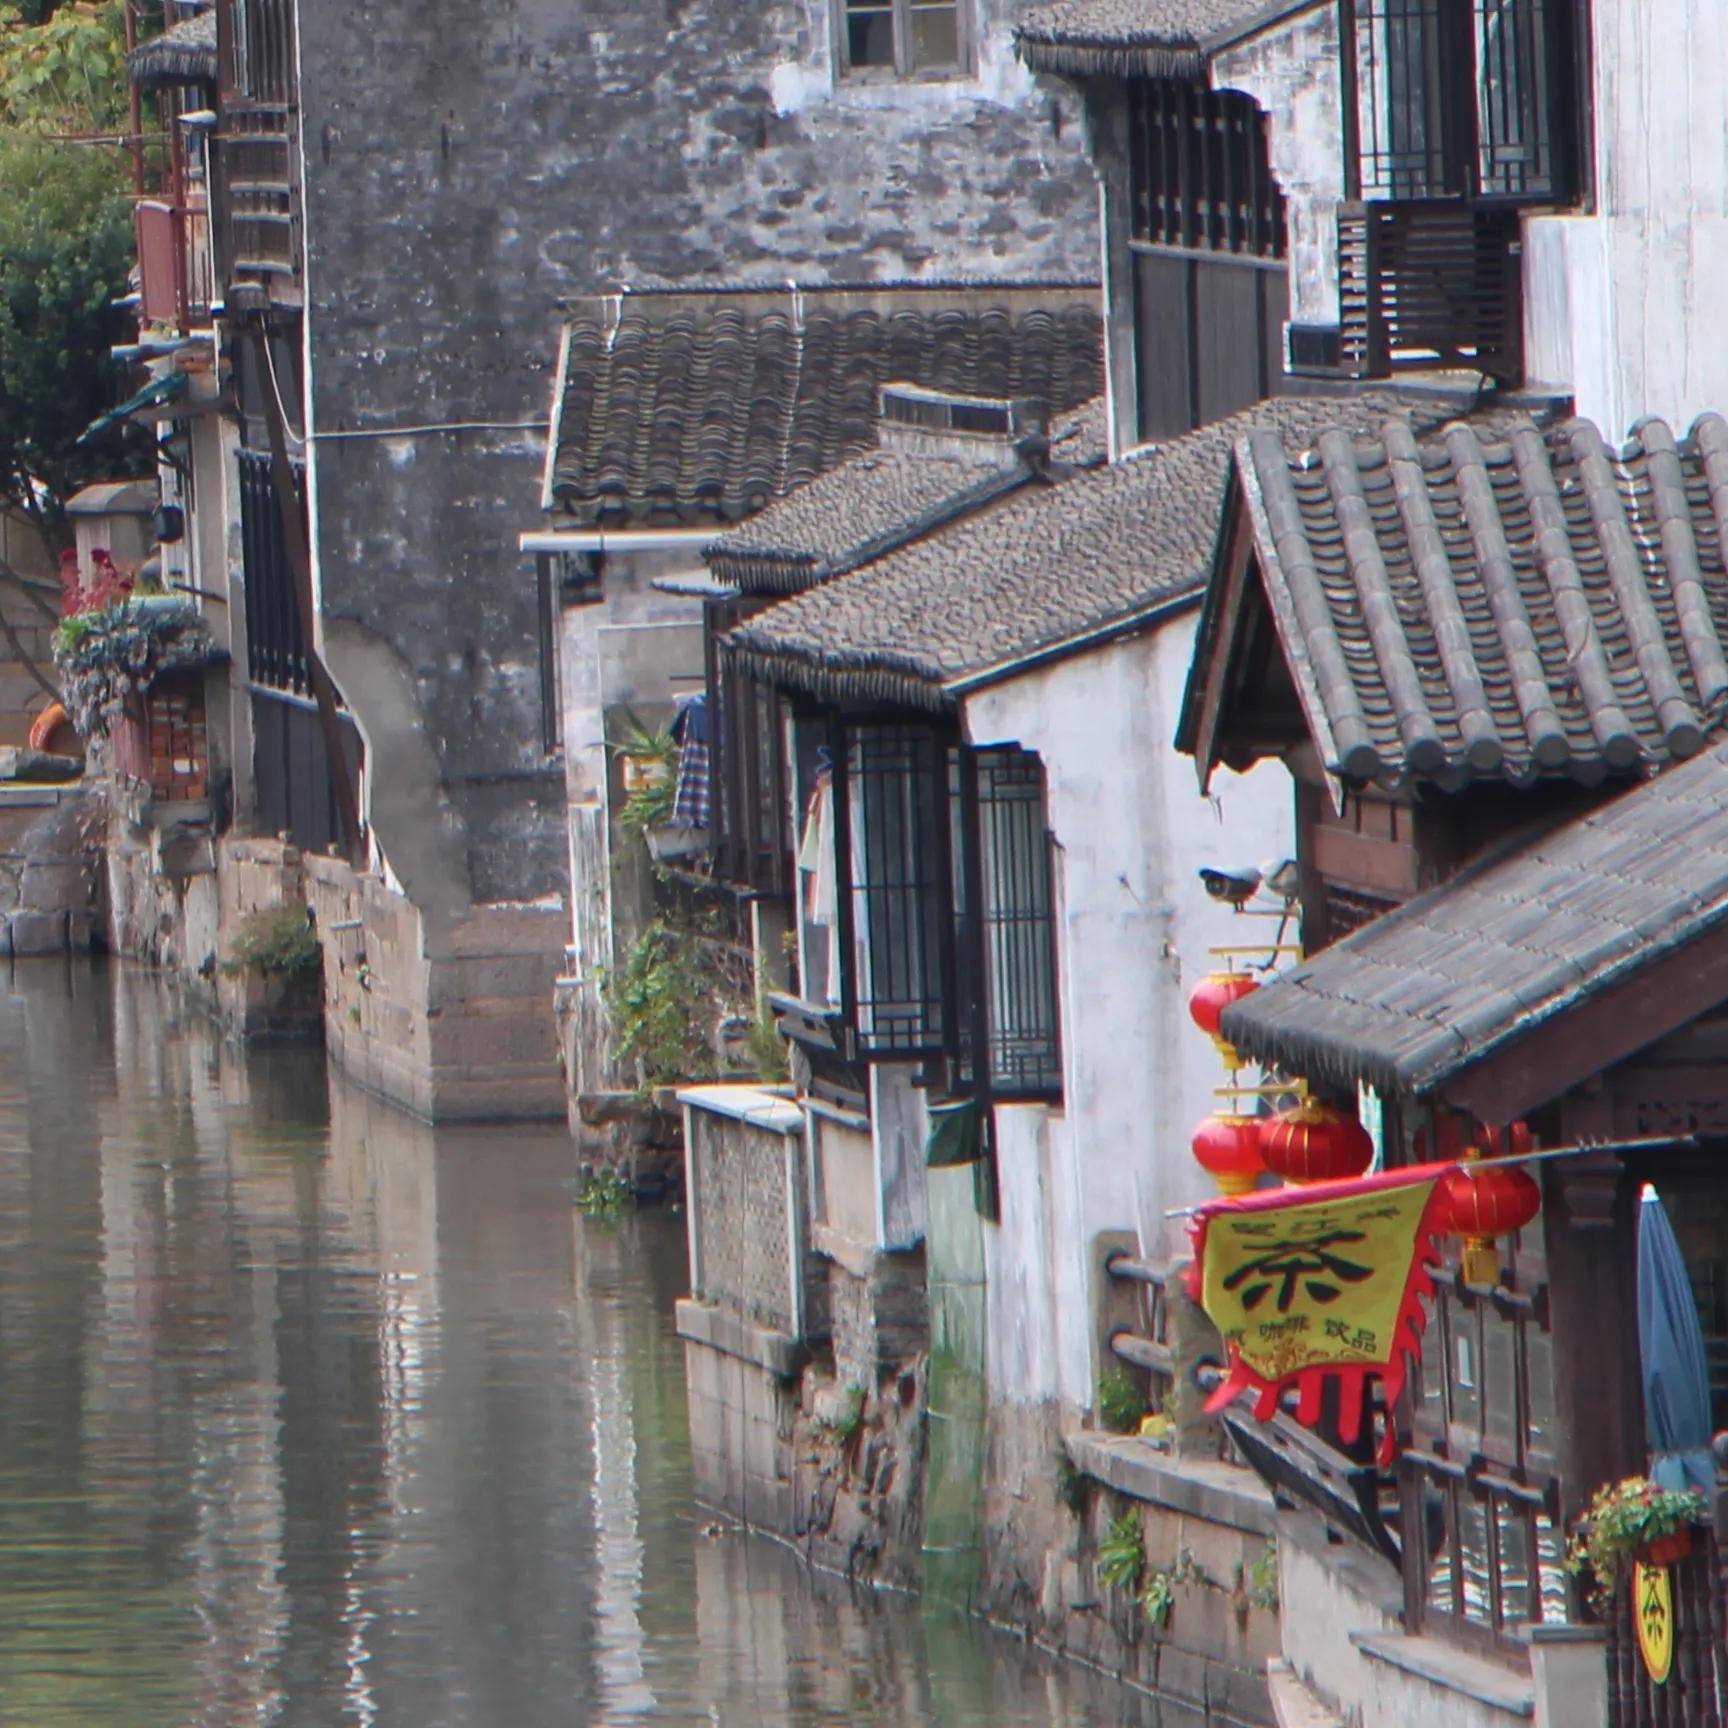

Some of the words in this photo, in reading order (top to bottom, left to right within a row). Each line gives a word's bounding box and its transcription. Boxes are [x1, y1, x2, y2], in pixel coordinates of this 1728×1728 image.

[1222, 1229, 1375, 1313] 茶
[1324, 1317, 1378, 1355] 饮品
[1642, 1564, 1666, 1648] 茶
